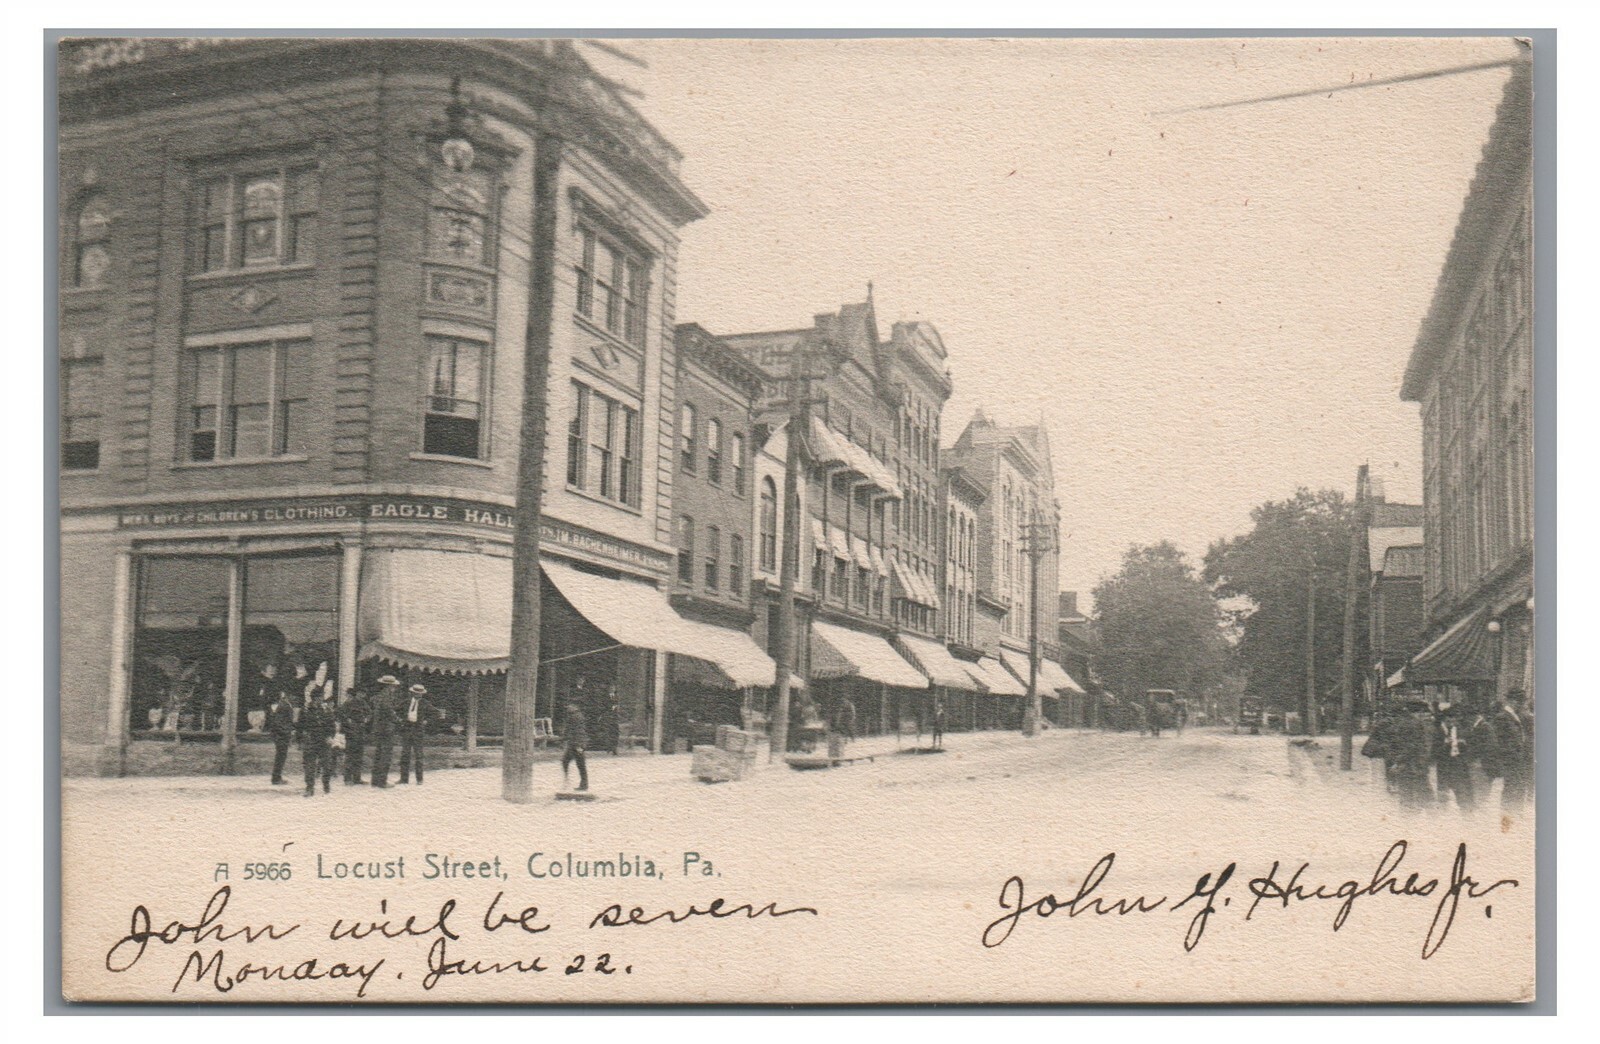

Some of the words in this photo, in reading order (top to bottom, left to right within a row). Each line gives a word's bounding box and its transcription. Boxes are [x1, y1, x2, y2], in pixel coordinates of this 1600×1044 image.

[370, 503, 448, 519] EAGLE
[464, 508, 516, 529] HALL
[106, 886, 300, 972] John
[329, 896, 461, 941] will
[483, 891, 551, 934] be
[588, 897, 818, 929] seven
[982, 852, 1167, 949] John
[1246, 839, 1439, 932] Hughes
[422, 936, 548, 991] June
[564, 953, 633, 976] 22.
